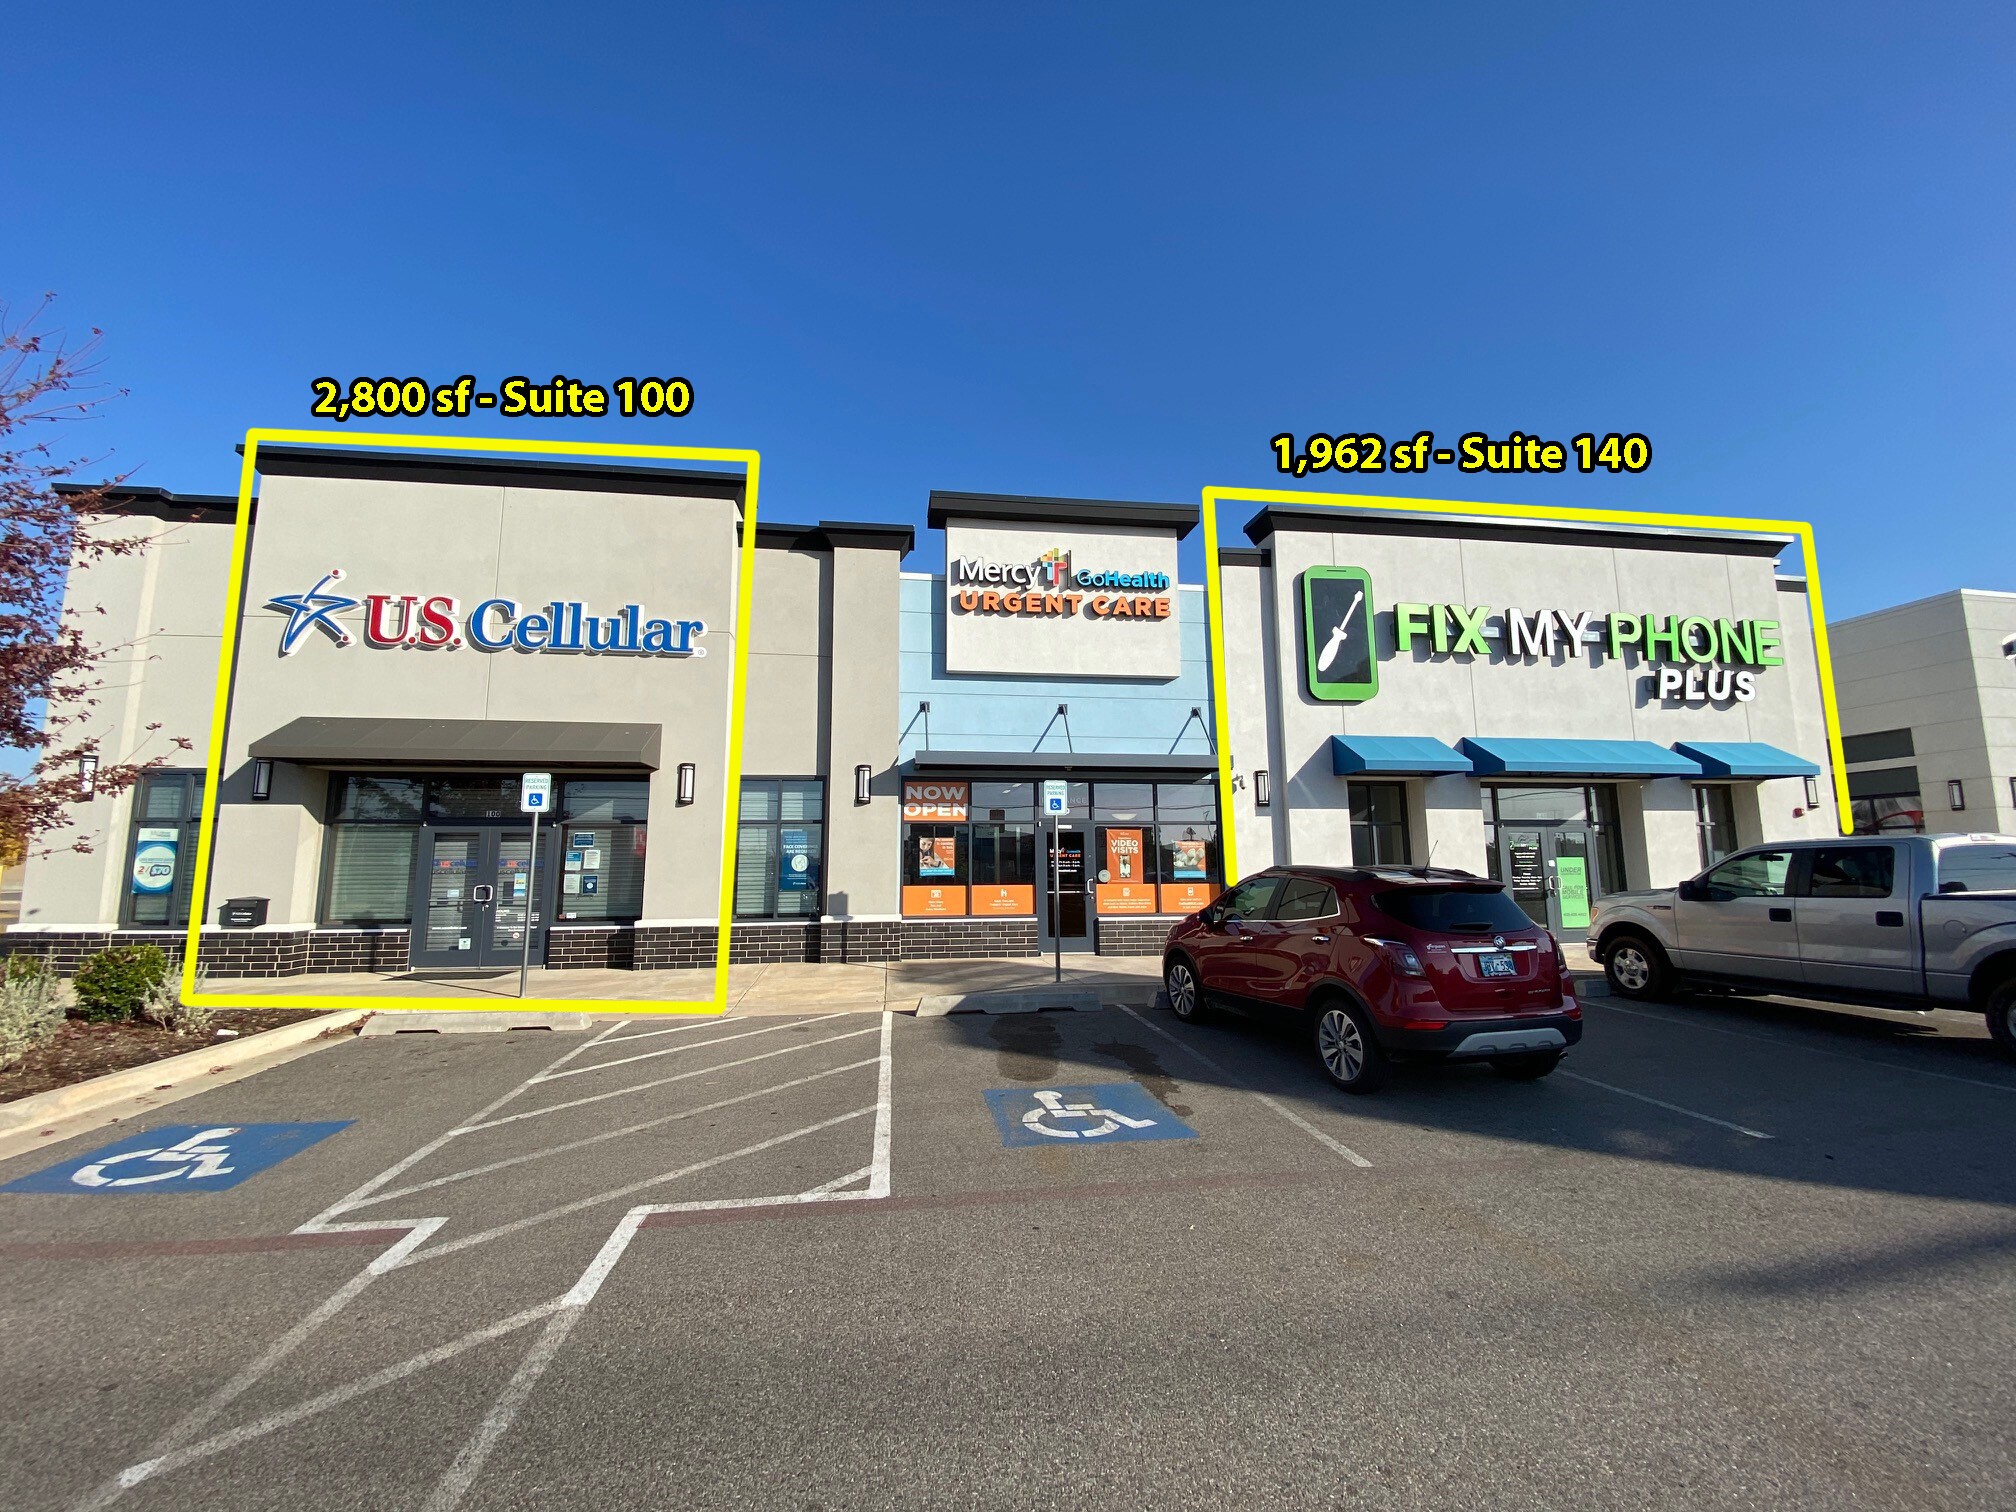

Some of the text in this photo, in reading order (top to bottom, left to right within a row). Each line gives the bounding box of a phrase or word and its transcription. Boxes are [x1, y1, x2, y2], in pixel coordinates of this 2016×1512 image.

[958, 554, 1171, 590] Mercy GoHealth
[958, 589, 1172, 617] URGENT CARE
[364, 593, 705, 654] U.S. Cellular
[1393, 601, 1784, 667] FIX MY PHONE
[1656, 668, 1757, 702] PLUS
[905, 785, 966, 800] NOW
[485, 810, 501, 818] 100
[903, 802, 968, 817] OPEN
[1111, 839, 1139, 847] VIDEO
[1111, 846, 1139, 854] VISITS
